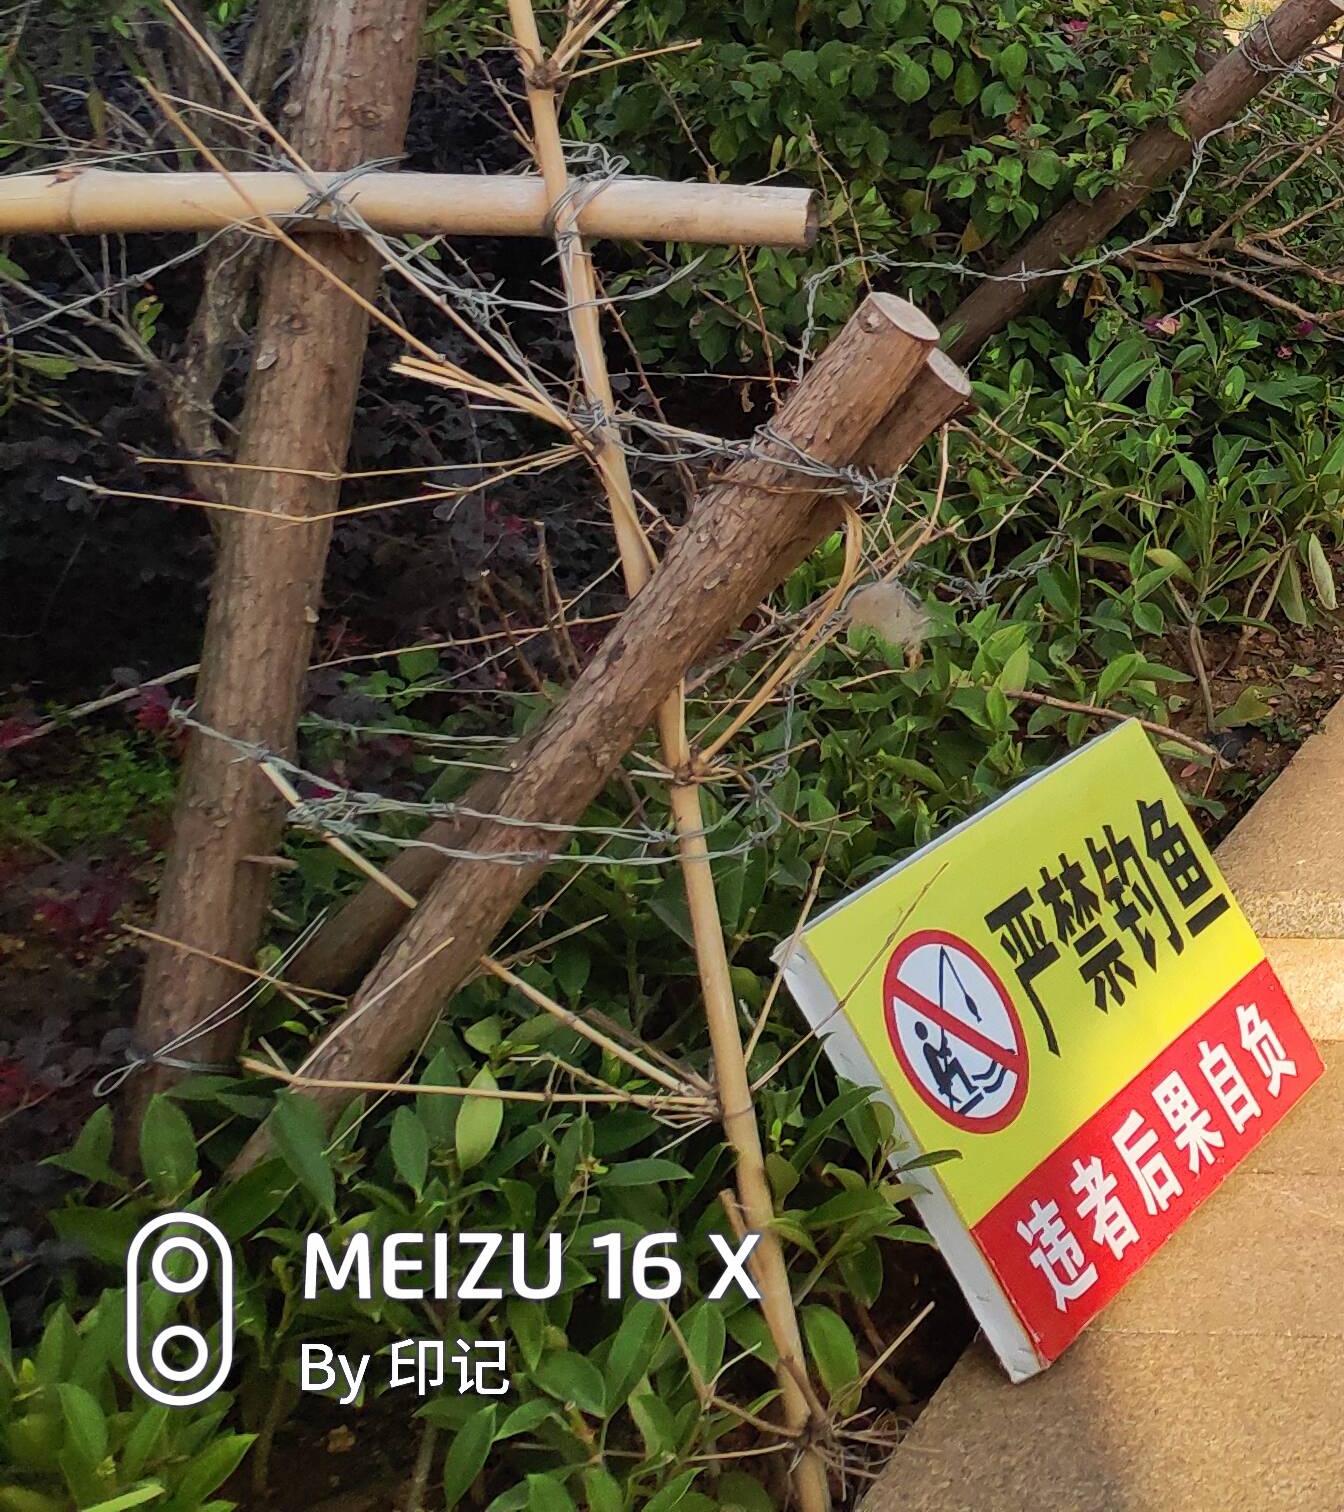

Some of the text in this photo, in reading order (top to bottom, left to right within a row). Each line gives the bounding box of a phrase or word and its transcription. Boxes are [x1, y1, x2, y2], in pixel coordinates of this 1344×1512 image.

[983, 799, 1230, 1058] 严禁钓鱼
[1016, 1002, 1299, 1313] 违者后果自负
